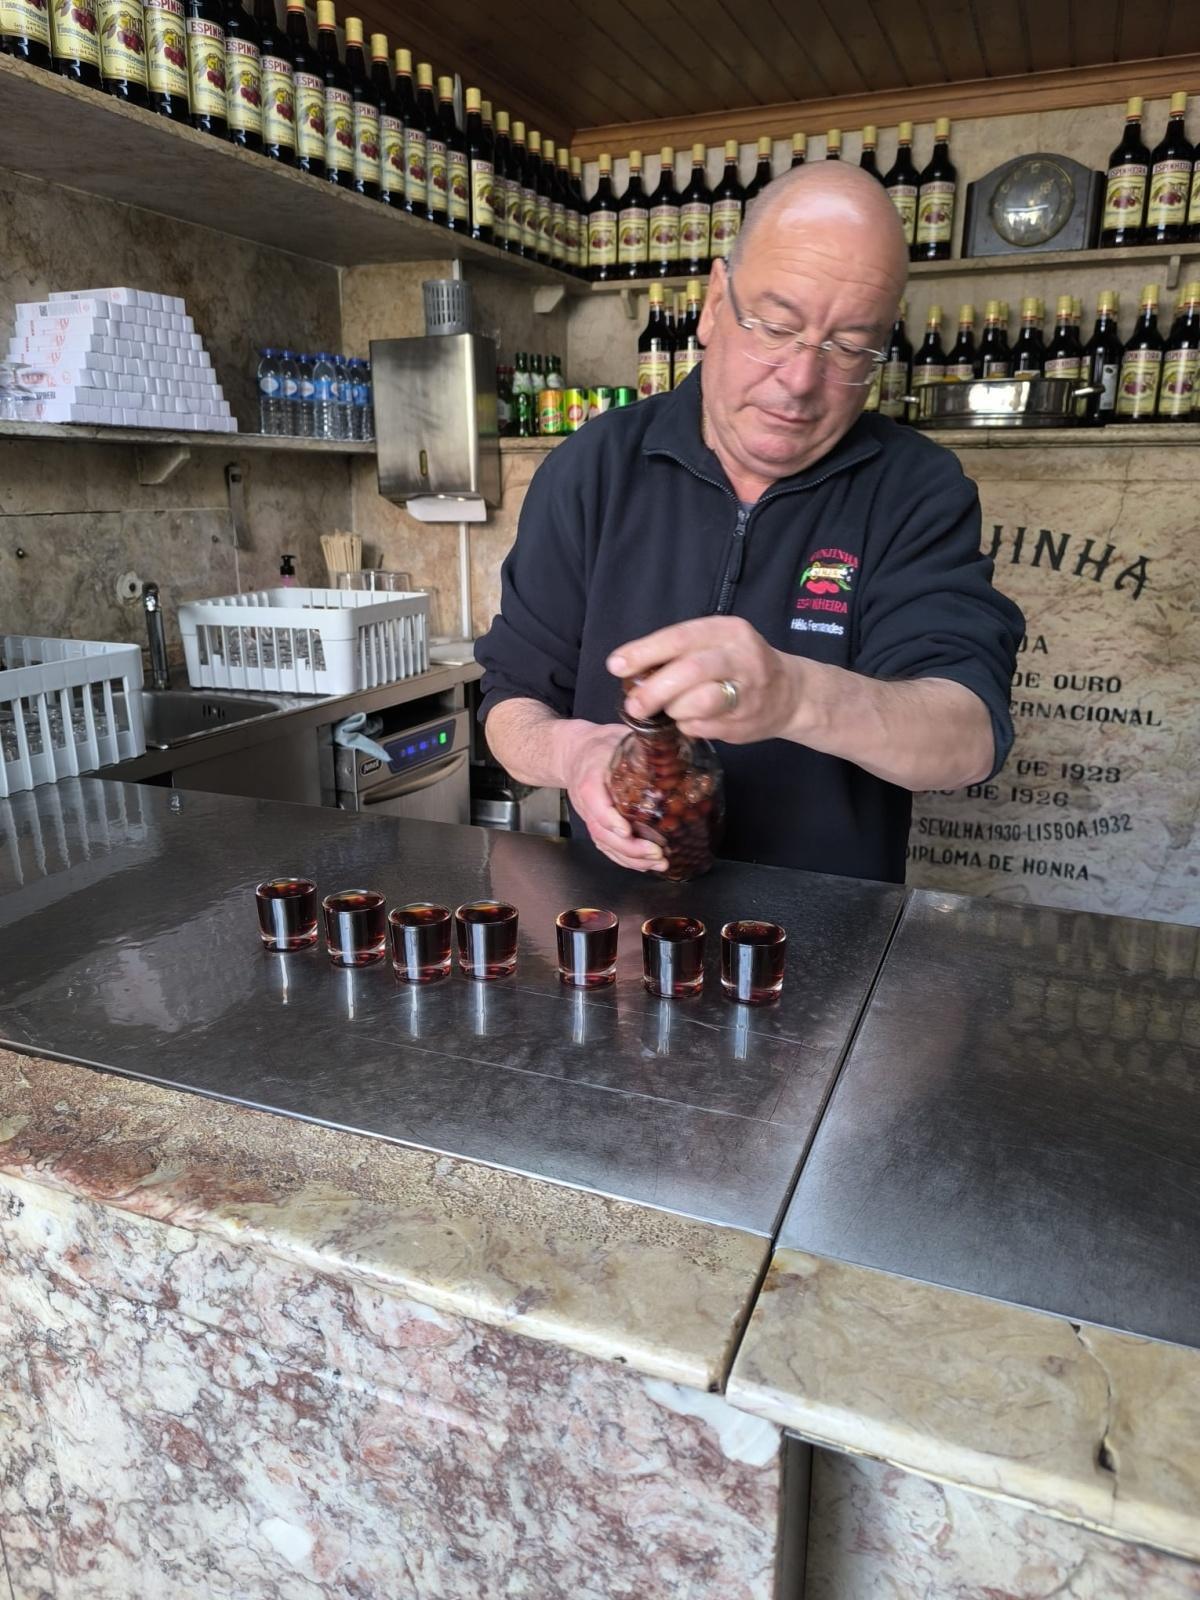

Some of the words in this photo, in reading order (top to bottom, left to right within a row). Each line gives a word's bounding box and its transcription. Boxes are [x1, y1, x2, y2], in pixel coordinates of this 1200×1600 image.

[1054, 674, 1122, 694] OURO
[1016, 759, 1048, 777] DE
[966, 785, 999, 801] DE
[988, 854, 1014, 873] DE
[1022, 858, 1089, 881] HONRA
